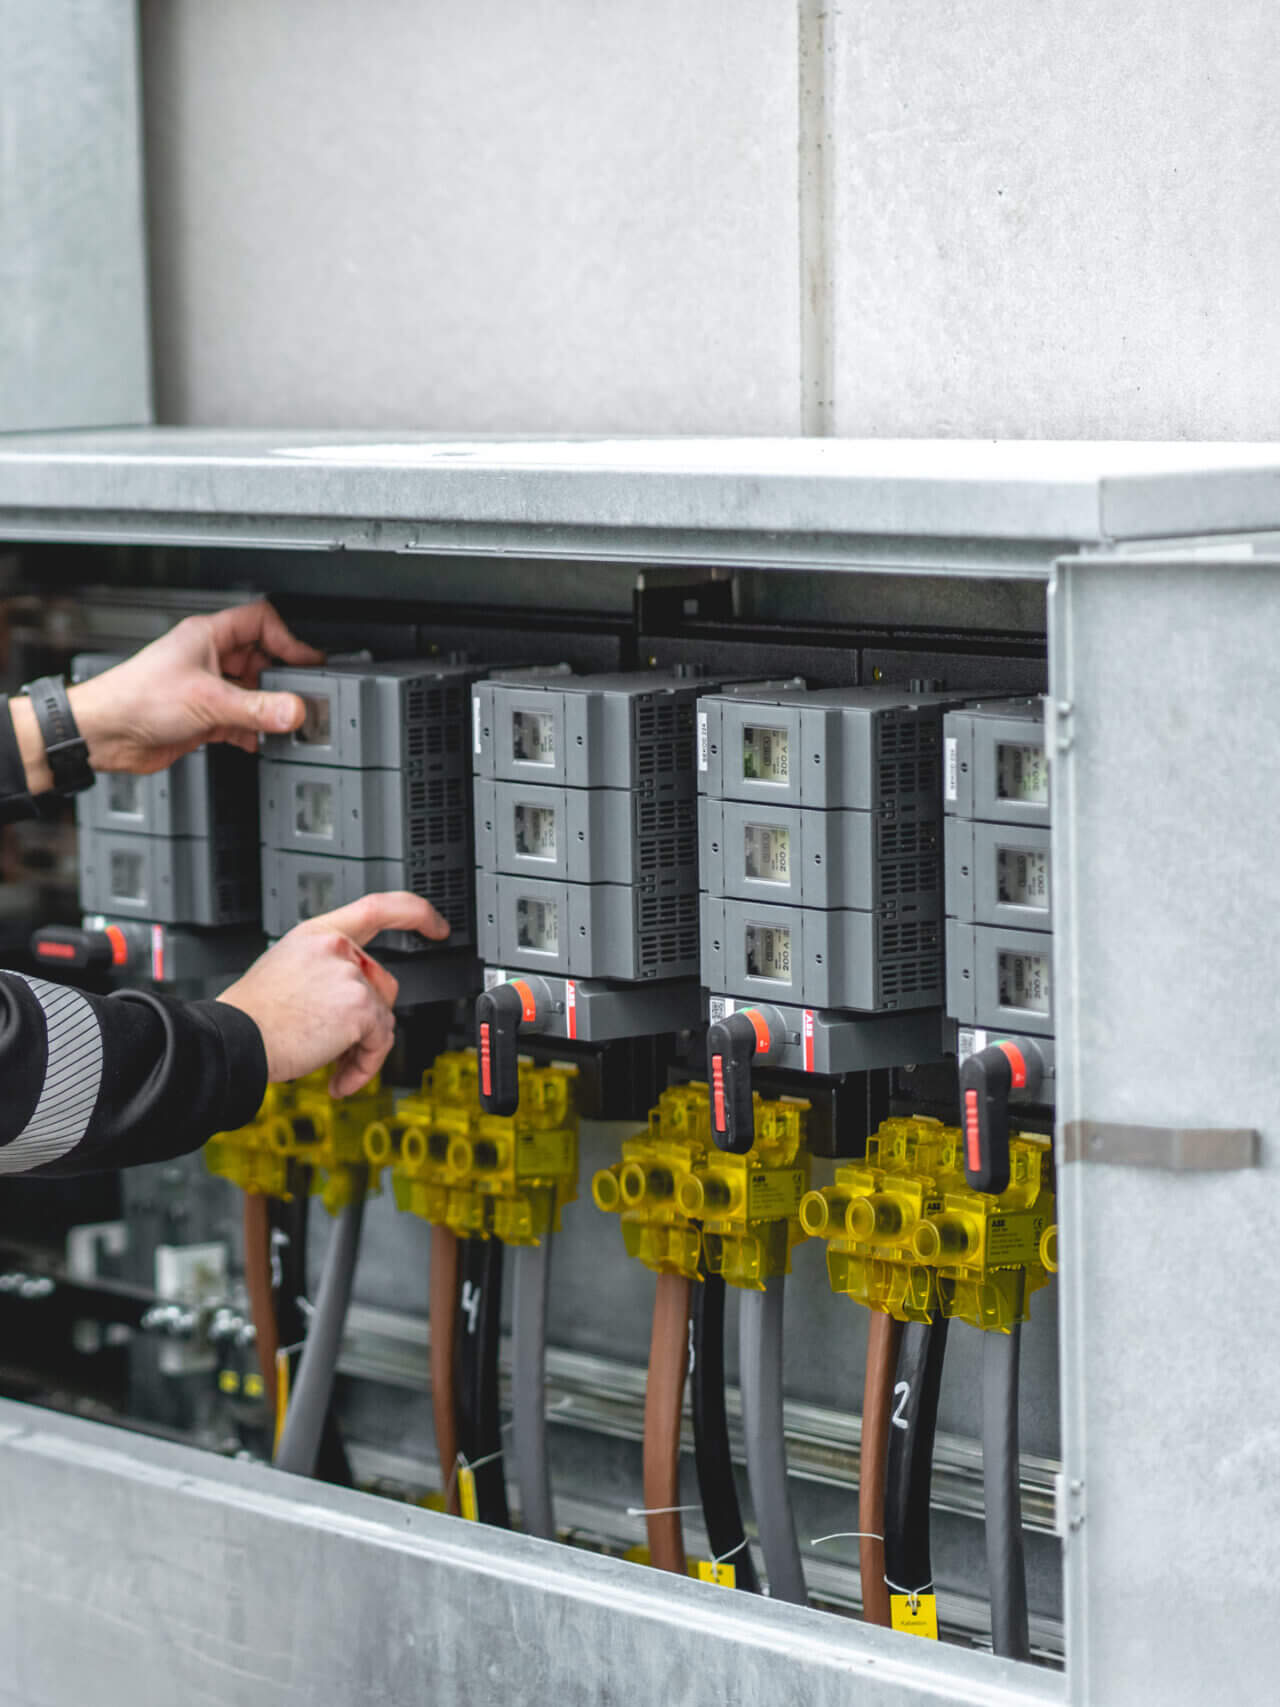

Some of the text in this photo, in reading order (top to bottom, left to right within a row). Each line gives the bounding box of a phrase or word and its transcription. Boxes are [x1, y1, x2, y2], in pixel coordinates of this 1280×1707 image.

[806, 1014, 815, 1037] ABB
[462, 1280, 481, 1335] 4
[892, 1381, 910, 1429] 2
